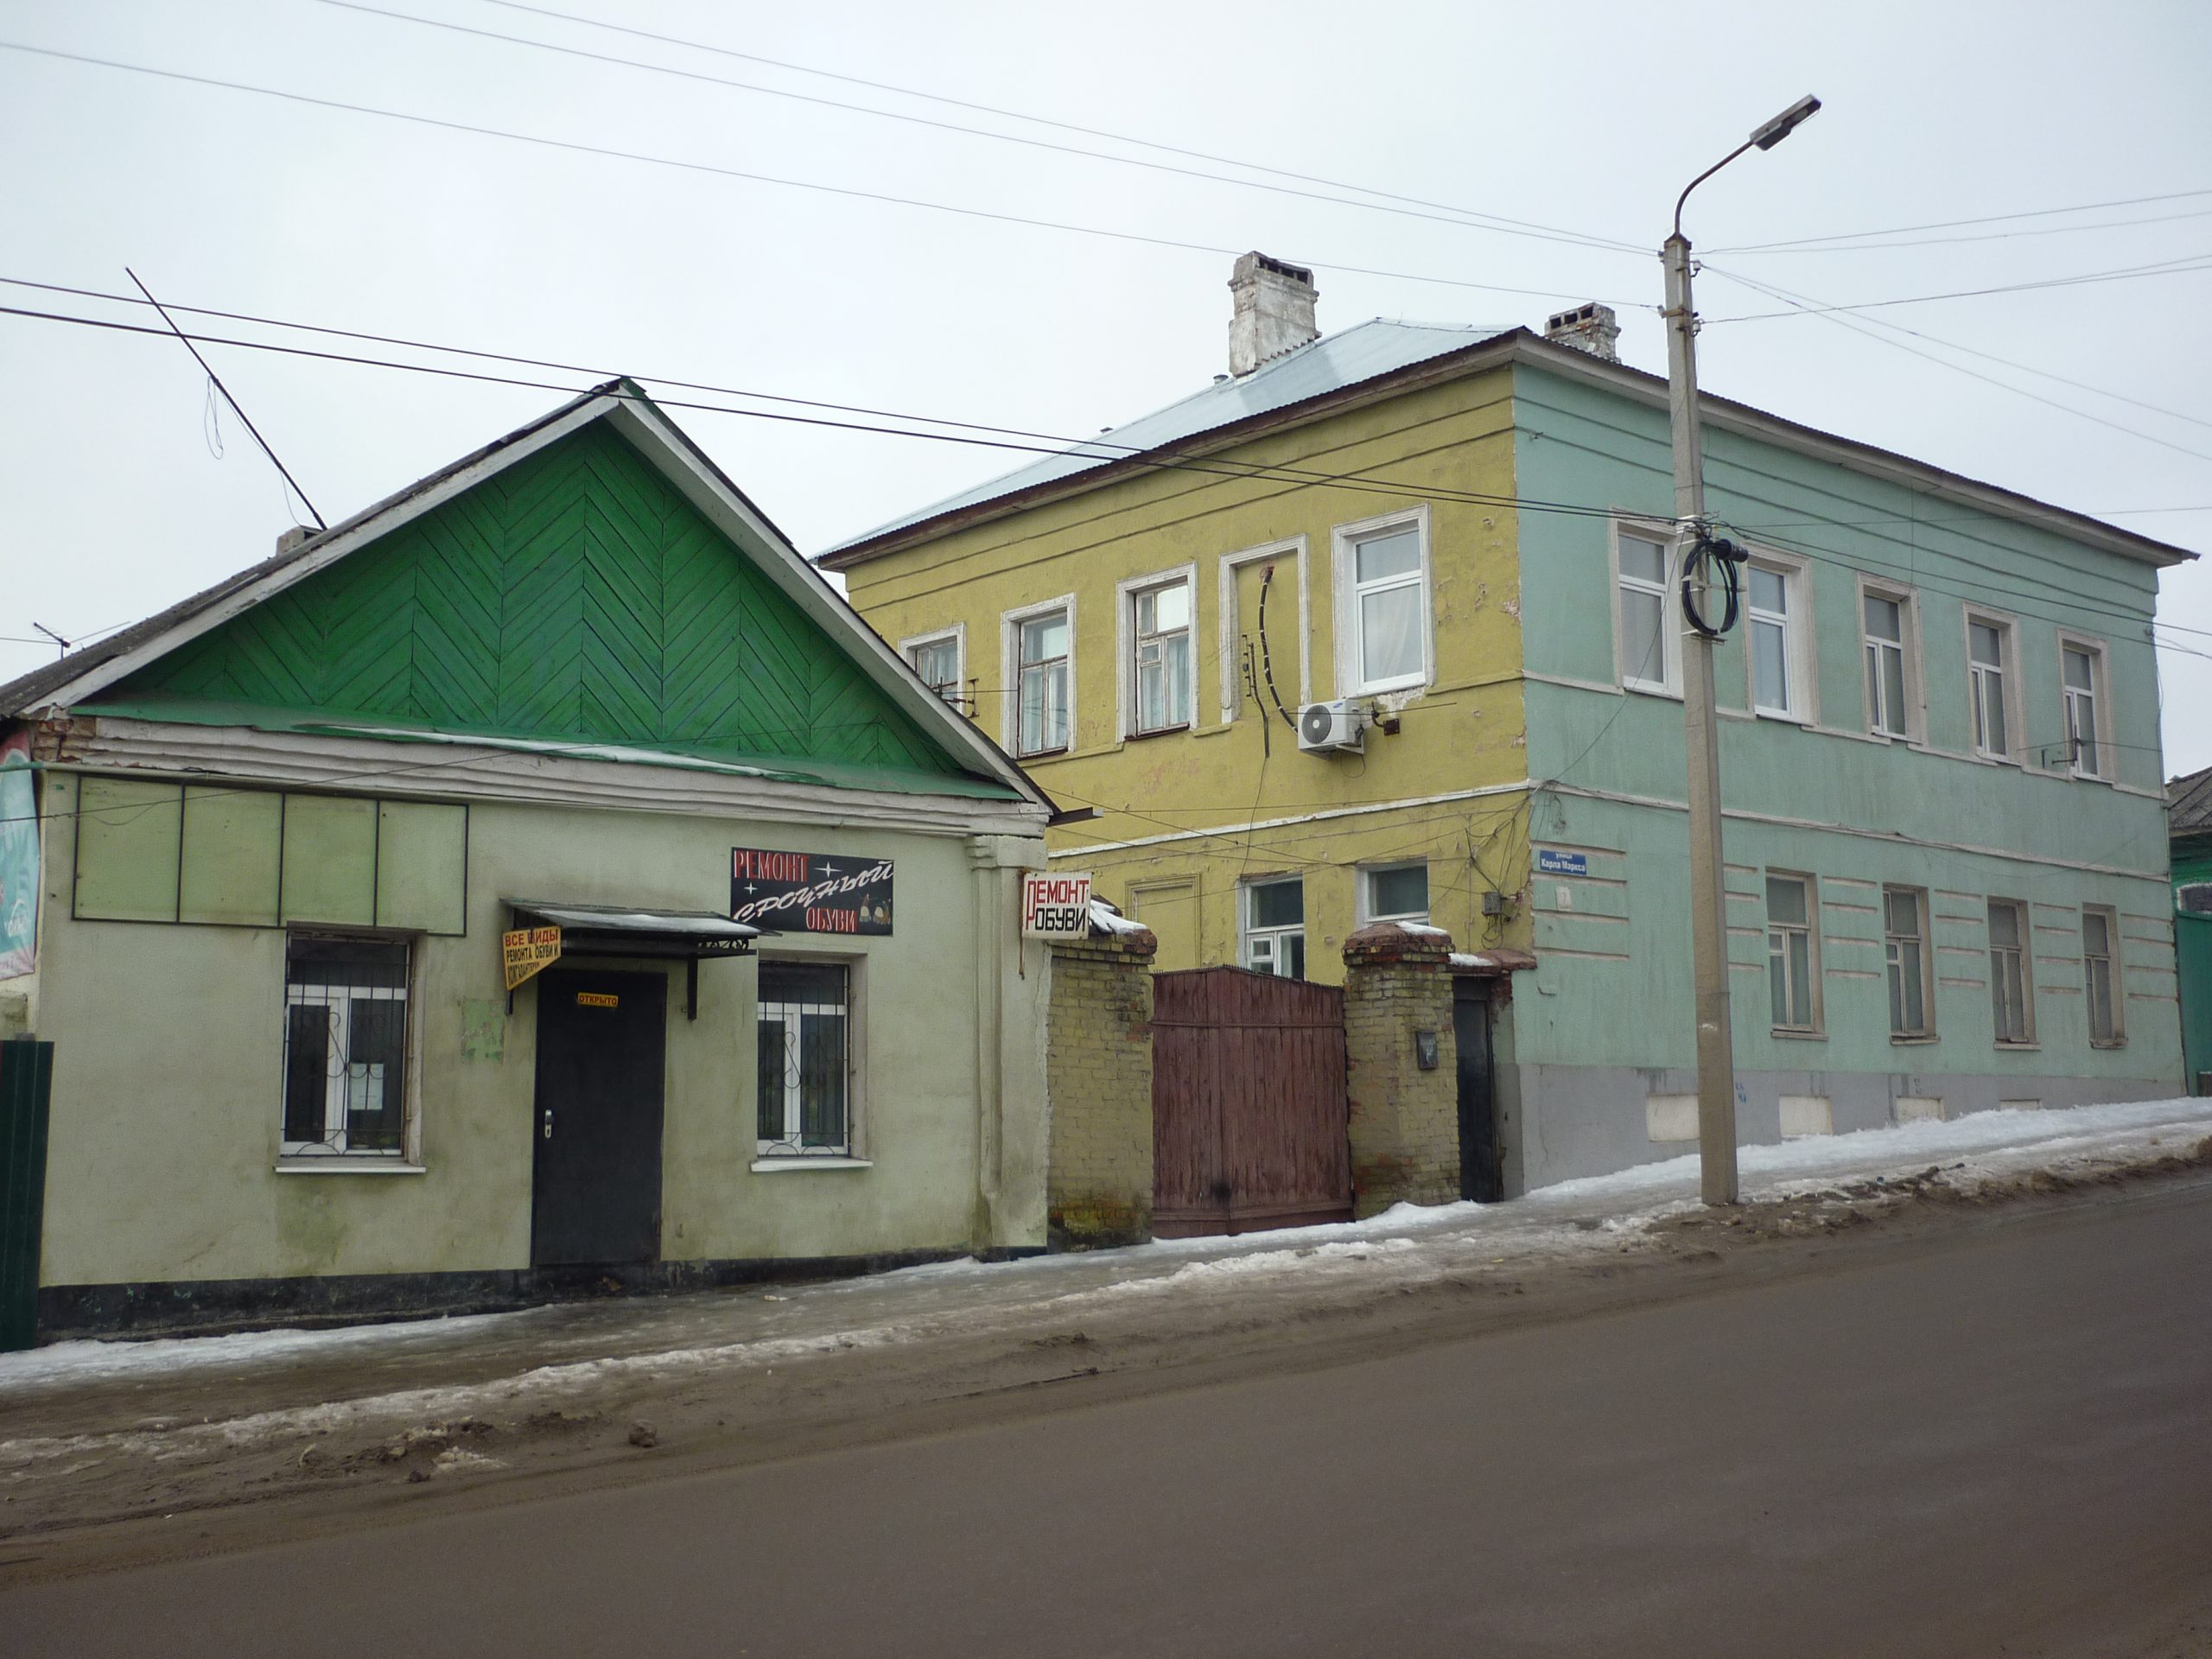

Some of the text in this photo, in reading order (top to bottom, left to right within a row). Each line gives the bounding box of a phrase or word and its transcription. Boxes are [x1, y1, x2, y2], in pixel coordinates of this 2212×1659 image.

[734, 850, 810, 881] РЕМОНТ
[1541, 858, 1585, 872] Карла Маркса
[1026, 880, 1090, 931] РЕМОНТ
[805, 906, 858, 932] ОБУВИ
[1035, 907, 1086, 931] ОБУВИ
[505, 929, 558, 947] ВСЕ ВИДЫ
[506, 947, 533, 963] РЕМОНТА
[535, 944, 554, 959] ОБУВИ
[579, 995, 617, 1006] ОТКРЫТО
